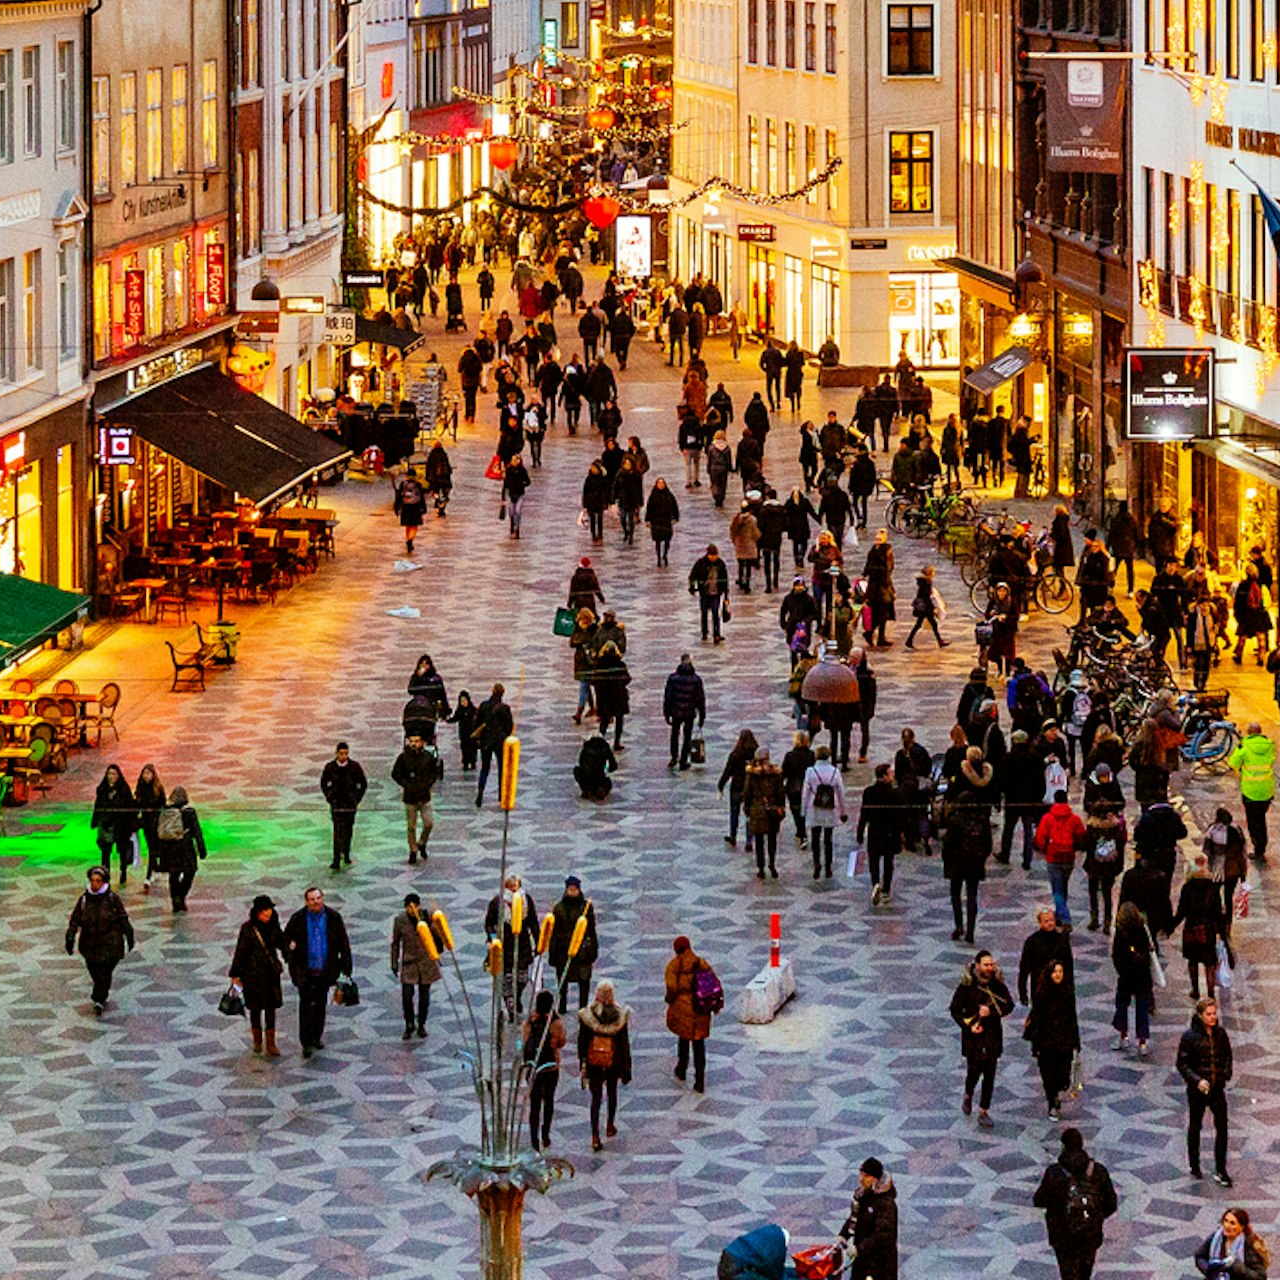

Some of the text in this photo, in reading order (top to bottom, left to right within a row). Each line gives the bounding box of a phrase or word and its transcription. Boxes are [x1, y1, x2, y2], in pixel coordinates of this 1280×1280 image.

[1051, 146, 1120, 160] Illums Bolighus
[738, 226, 771, 236] CHANGE
[208, 264, 222, 303] Floor
[127, 273, 142, 335] Art Shop
[326, 317, 354, 330] 琥珀
[325, 333, 354, 342] コハク
[1131, 393, 1208, 408] Illums Bolighus
